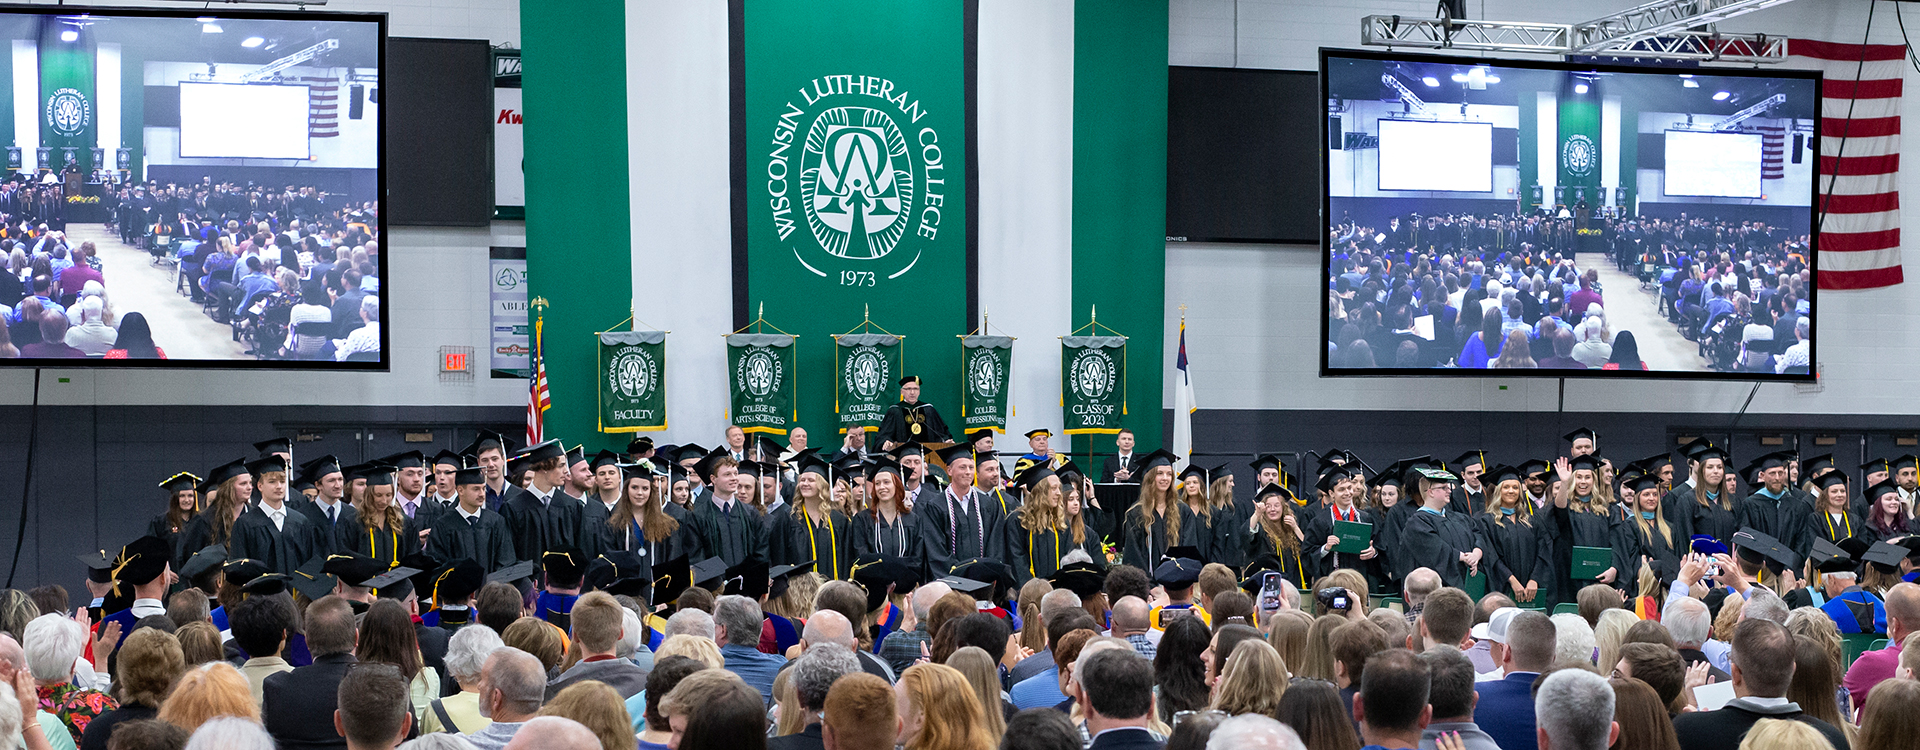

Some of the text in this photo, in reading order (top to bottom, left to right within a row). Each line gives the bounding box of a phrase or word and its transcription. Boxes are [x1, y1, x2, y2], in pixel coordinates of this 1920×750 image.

[768, 74, 945, 242] WISCONSIN LUTHERAN COLLEGE
[839, 270, 876, 287] 1973
[446, 354, 467, 370] EXIT
[742, 404, 768, 413] COLLEGE
[849, 404, 877, 412] COLLEGE
[974, 406, 997, 414] COLLEG
[1073, 404, 1114, 414] CLASS OF
[614, 410, 654, 420] FACULTY
[754, 414, 785, 425] SCIENCES
[841, 413, 866, 422] HEALTH
[1082, 415, 1105, 425] 2023
